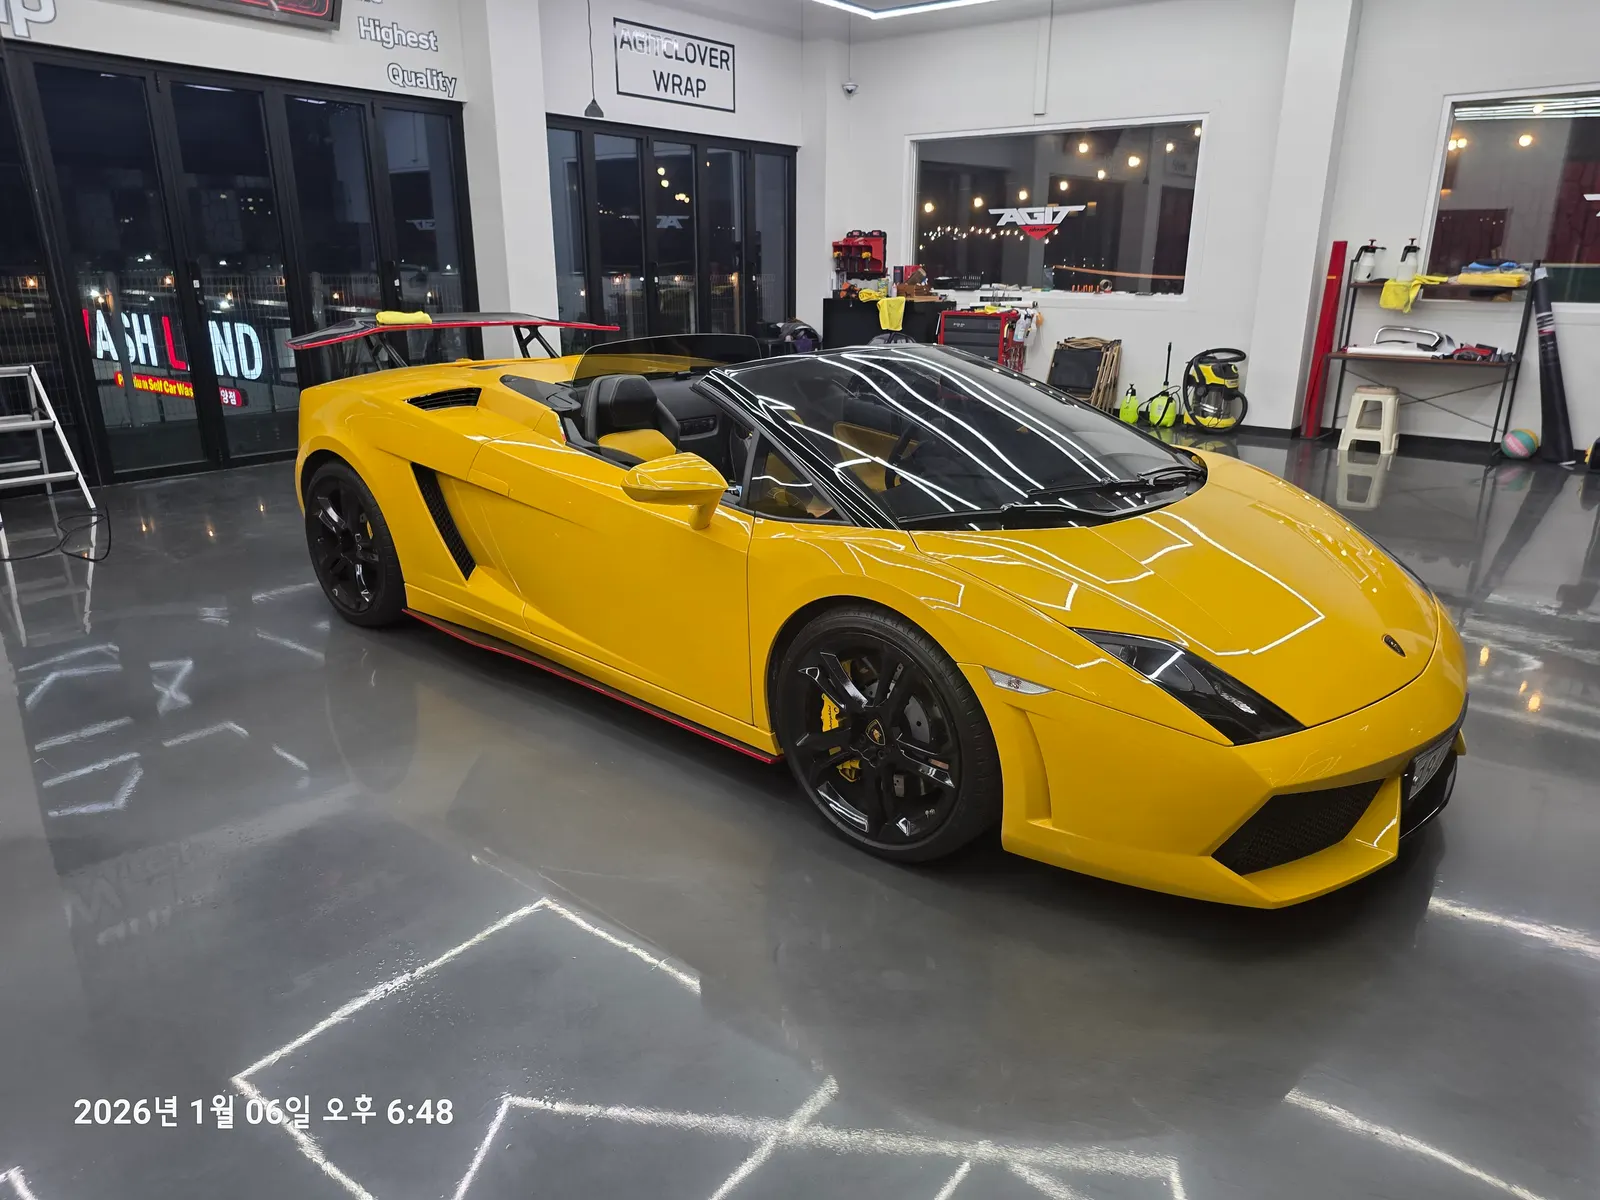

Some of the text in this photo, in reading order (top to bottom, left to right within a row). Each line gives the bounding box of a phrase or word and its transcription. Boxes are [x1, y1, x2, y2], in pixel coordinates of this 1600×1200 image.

[357, 16, 438, 52] Highest
[619, 28, 731, 71] AGITCLOVER
[387, 62, 457, 98] Quality
[652, 69, 707, 98] WRAP
[988, 205, 1086, 226] AGIT
[82, 309, 262, 380] ASH LND
[163, 380, 177, 395] Car
